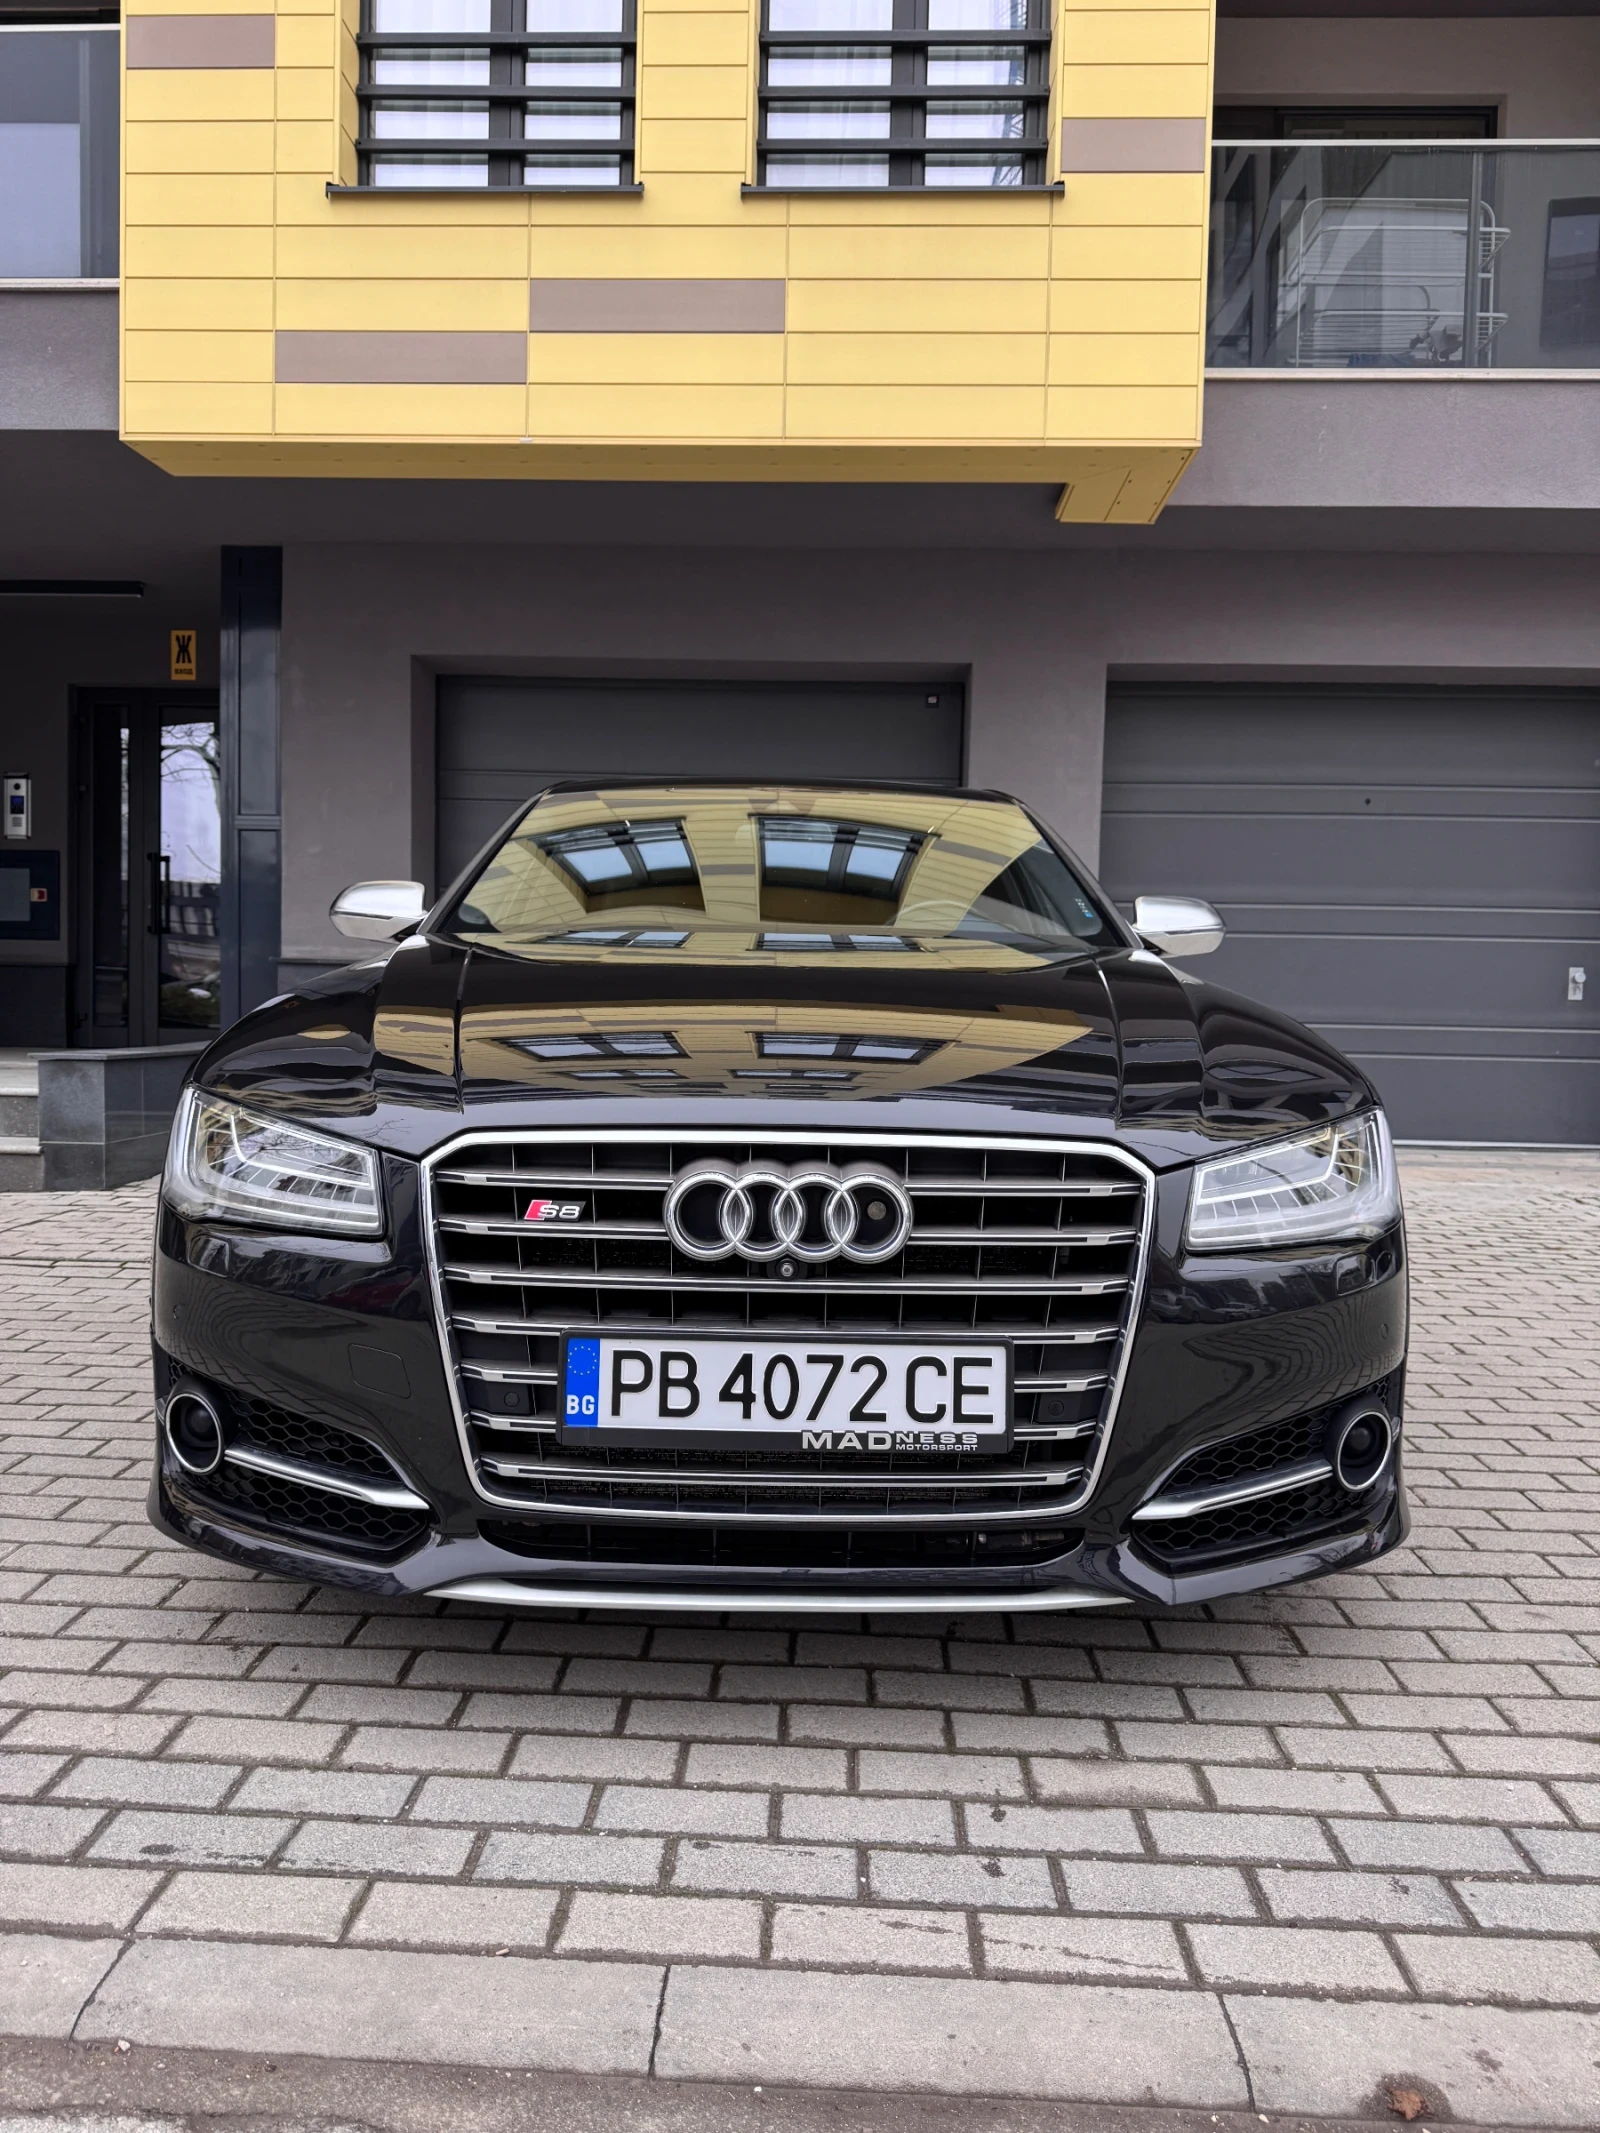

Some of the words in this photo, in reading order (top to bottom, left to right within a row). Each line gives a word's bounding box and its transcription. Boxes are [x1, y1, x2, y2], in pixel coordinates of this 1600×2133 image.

[537, 1204, 580, 1219] S8
[611, 1349, 701, 1418] PB
[718, 1352, 888, 1423] 4072
[905, 1355, 994, 1424] CE
[566, 1394, 595, 1415] BG
[801, 1432, 978, 1450] MADNESS
[895, 1443, 978, 1451] MOTORSPORT
